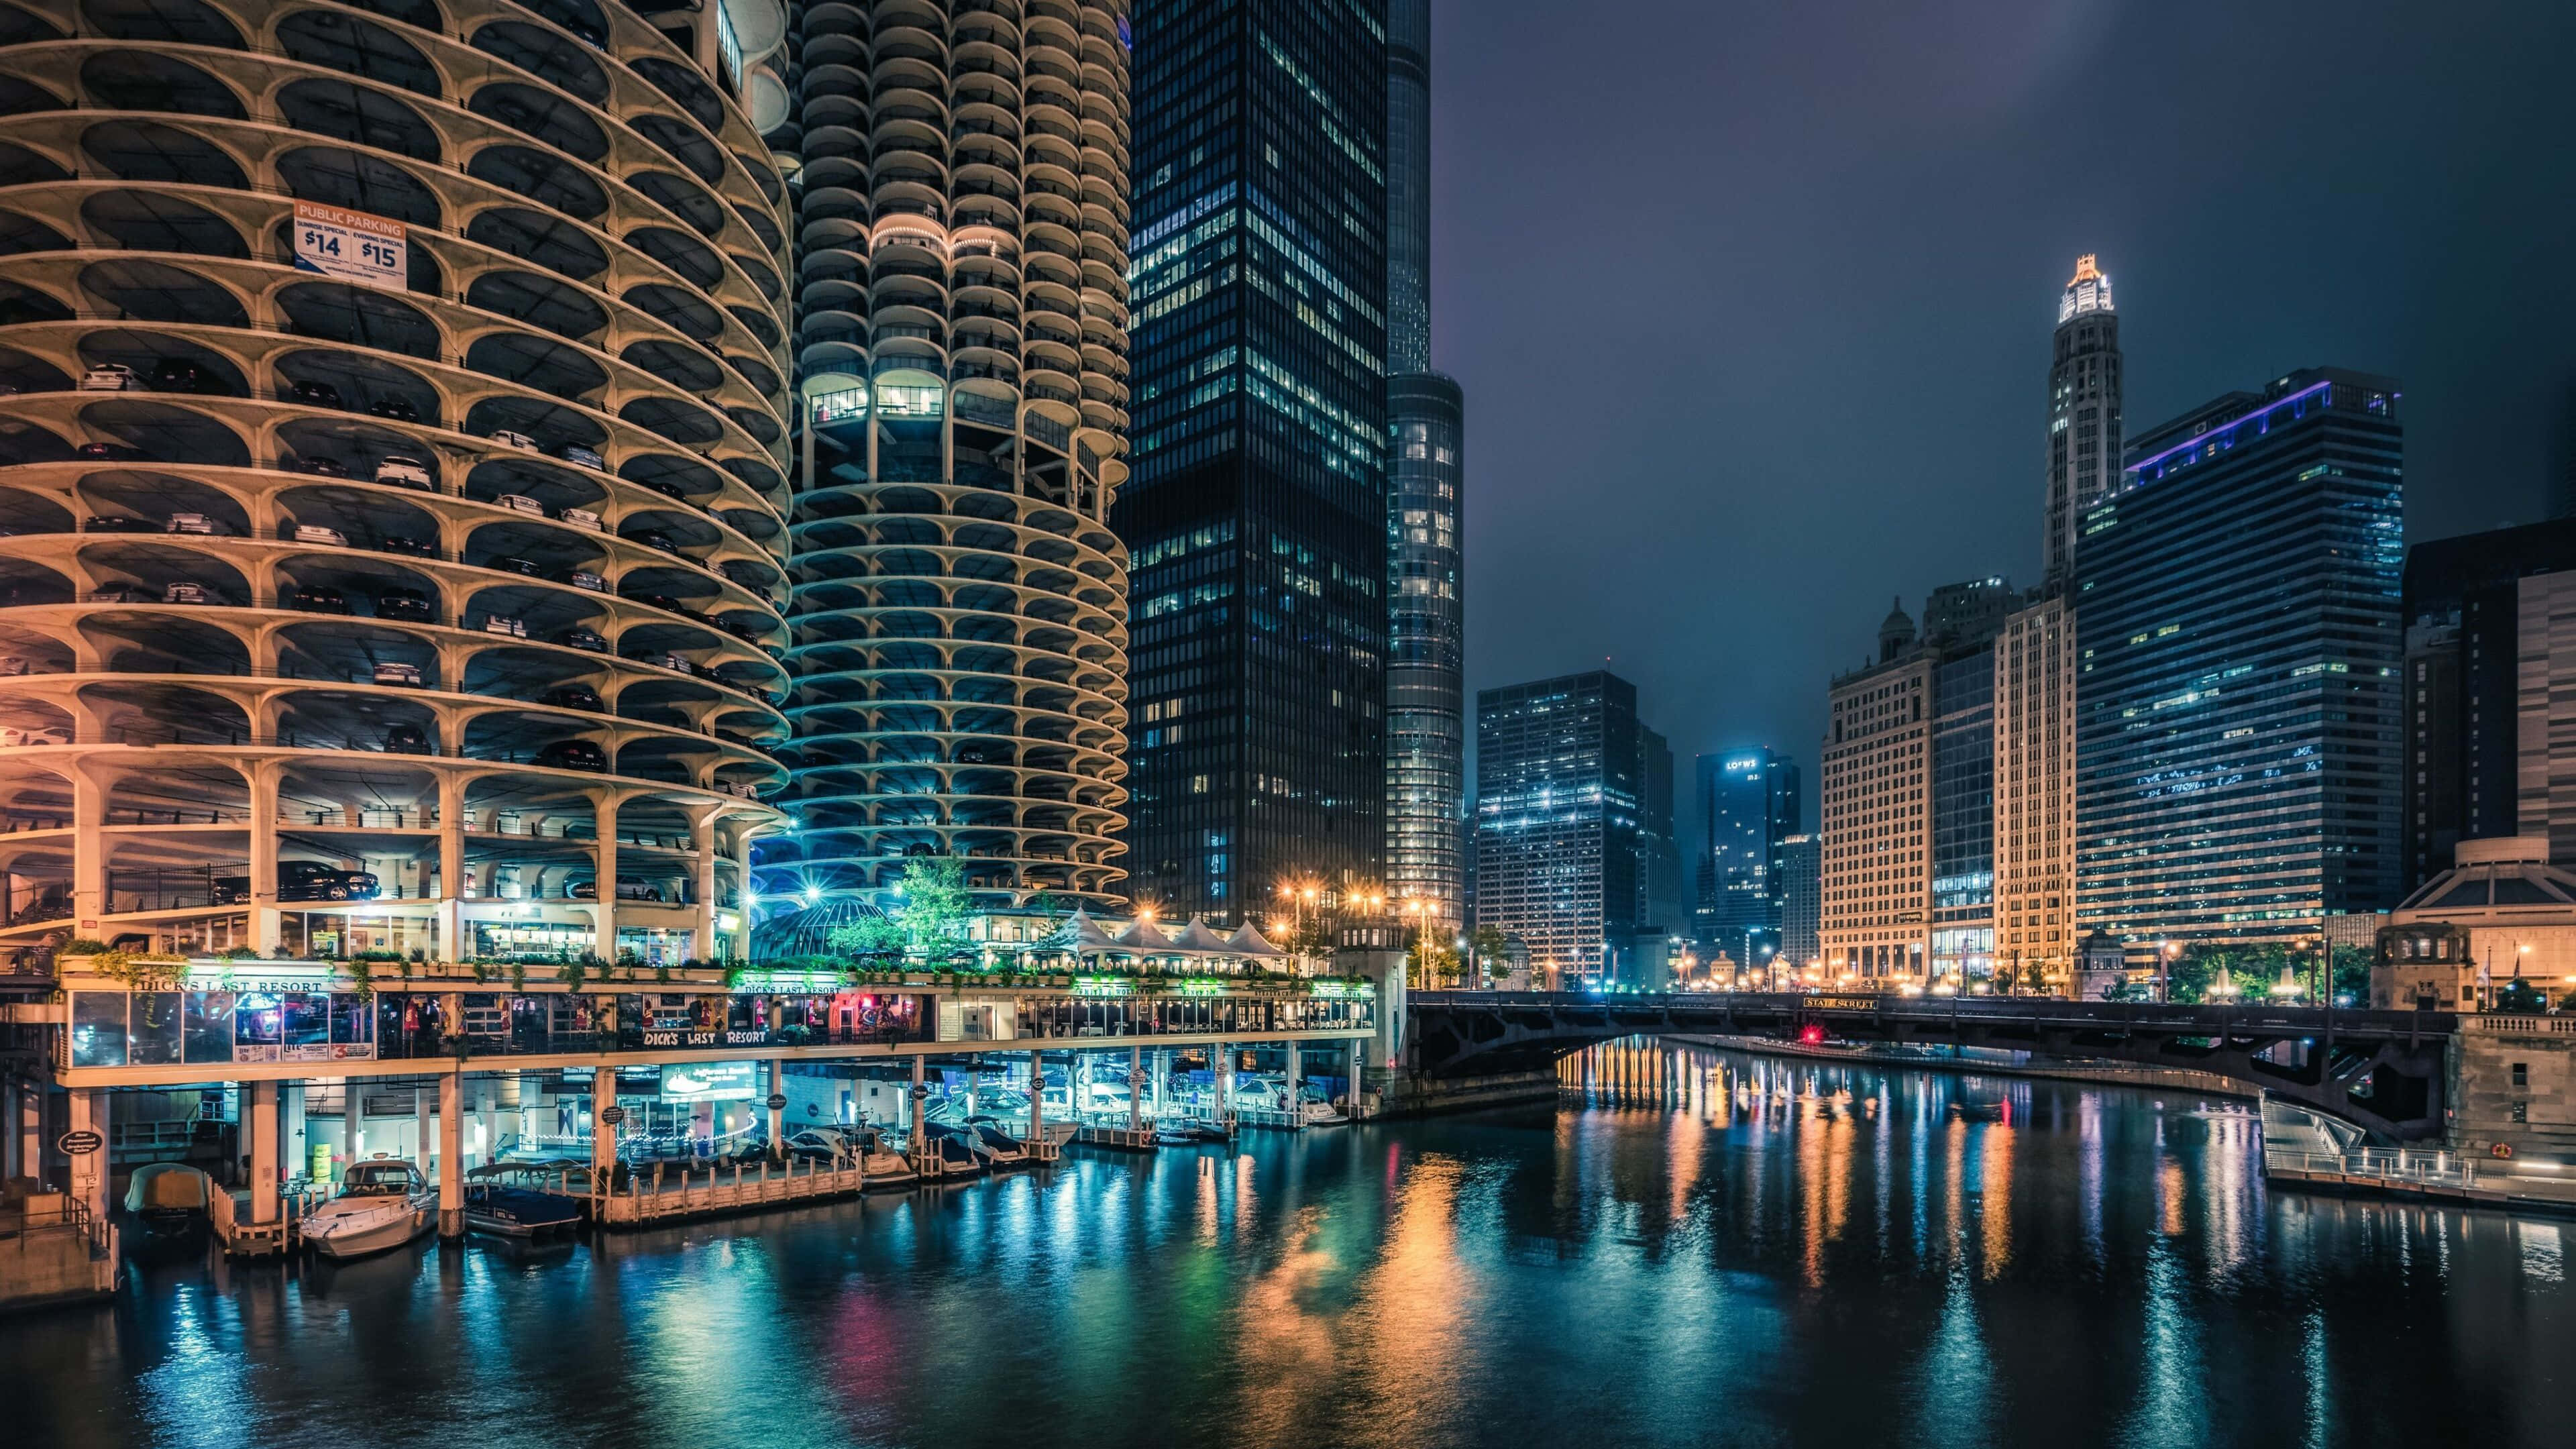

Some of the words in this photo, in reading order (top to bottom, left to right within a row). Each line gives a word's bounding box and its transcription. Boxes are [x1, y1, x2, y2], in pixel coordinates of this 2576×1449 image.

[300, 204, 344, 223] PUBLIC
[346, 215, 401, 235] PARKING
[297, 220, 323, 230] SUNRISE
[324, 225, 348, 236] SPECIAL
[305, 231, 341, 256] $14
[354, 232, 379, 242] EVENING
[380, 237, 404, 248] SPECIAL
[362, 242, 396, 268] $15
[1727, 759, 1756, 769] LOEWS
[141, 981, 199, 991] DICK'S
[207, 981, 250, 992] LAST
[258, 982, 322, 992] RESORT
[1837, 1000, 1875, 1008] STREET
[644, 1032, 678, 1046] DICK'S
[688, 1032, 716, 1044] LAST
[726, 1031, 766, 1044] RESORT
